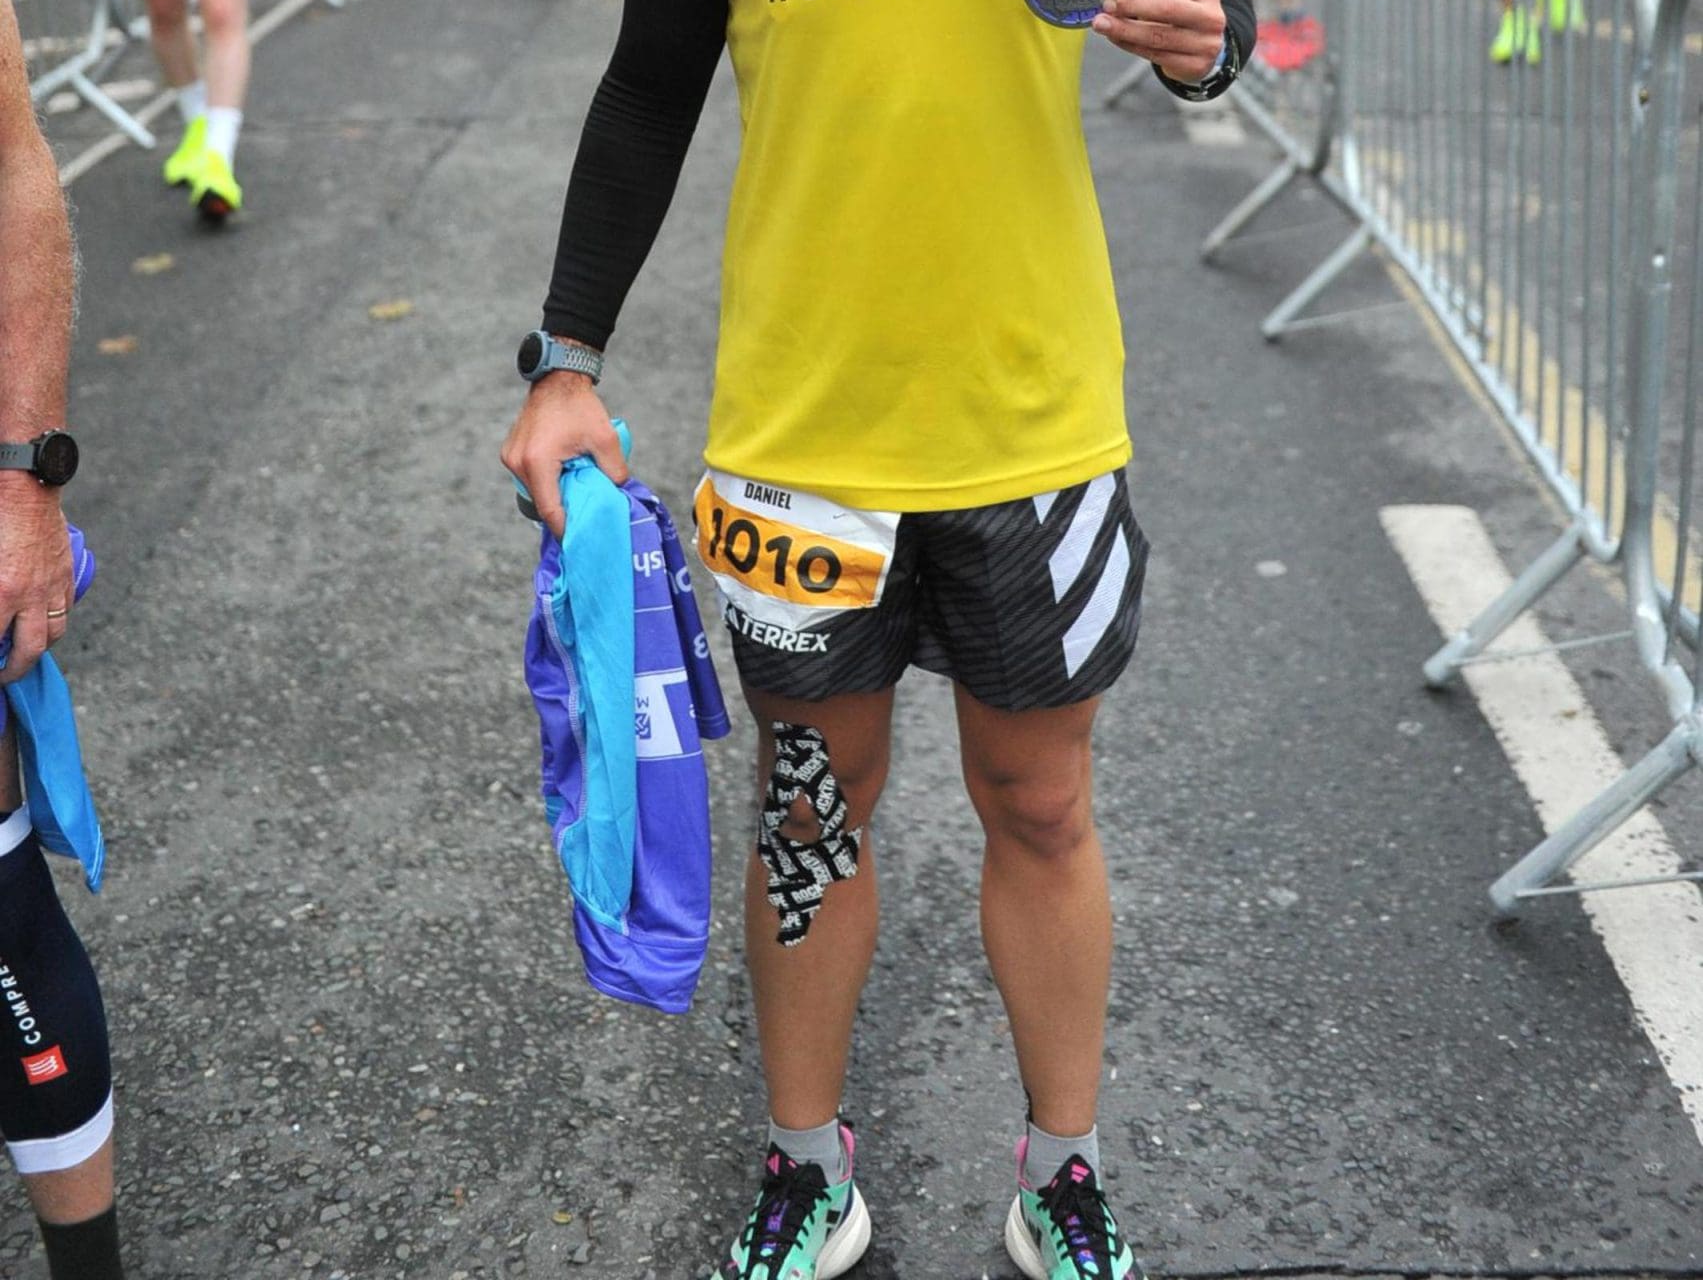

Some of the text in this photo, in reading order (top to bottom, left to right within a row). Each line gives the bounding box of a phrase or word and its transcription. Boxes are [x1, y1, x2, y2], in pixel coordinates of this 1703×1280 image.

[743, 481, 792, 511] DANIEL
[709, 507, 842, 594] 1010
[740, 613, 832, 653] TERREX
